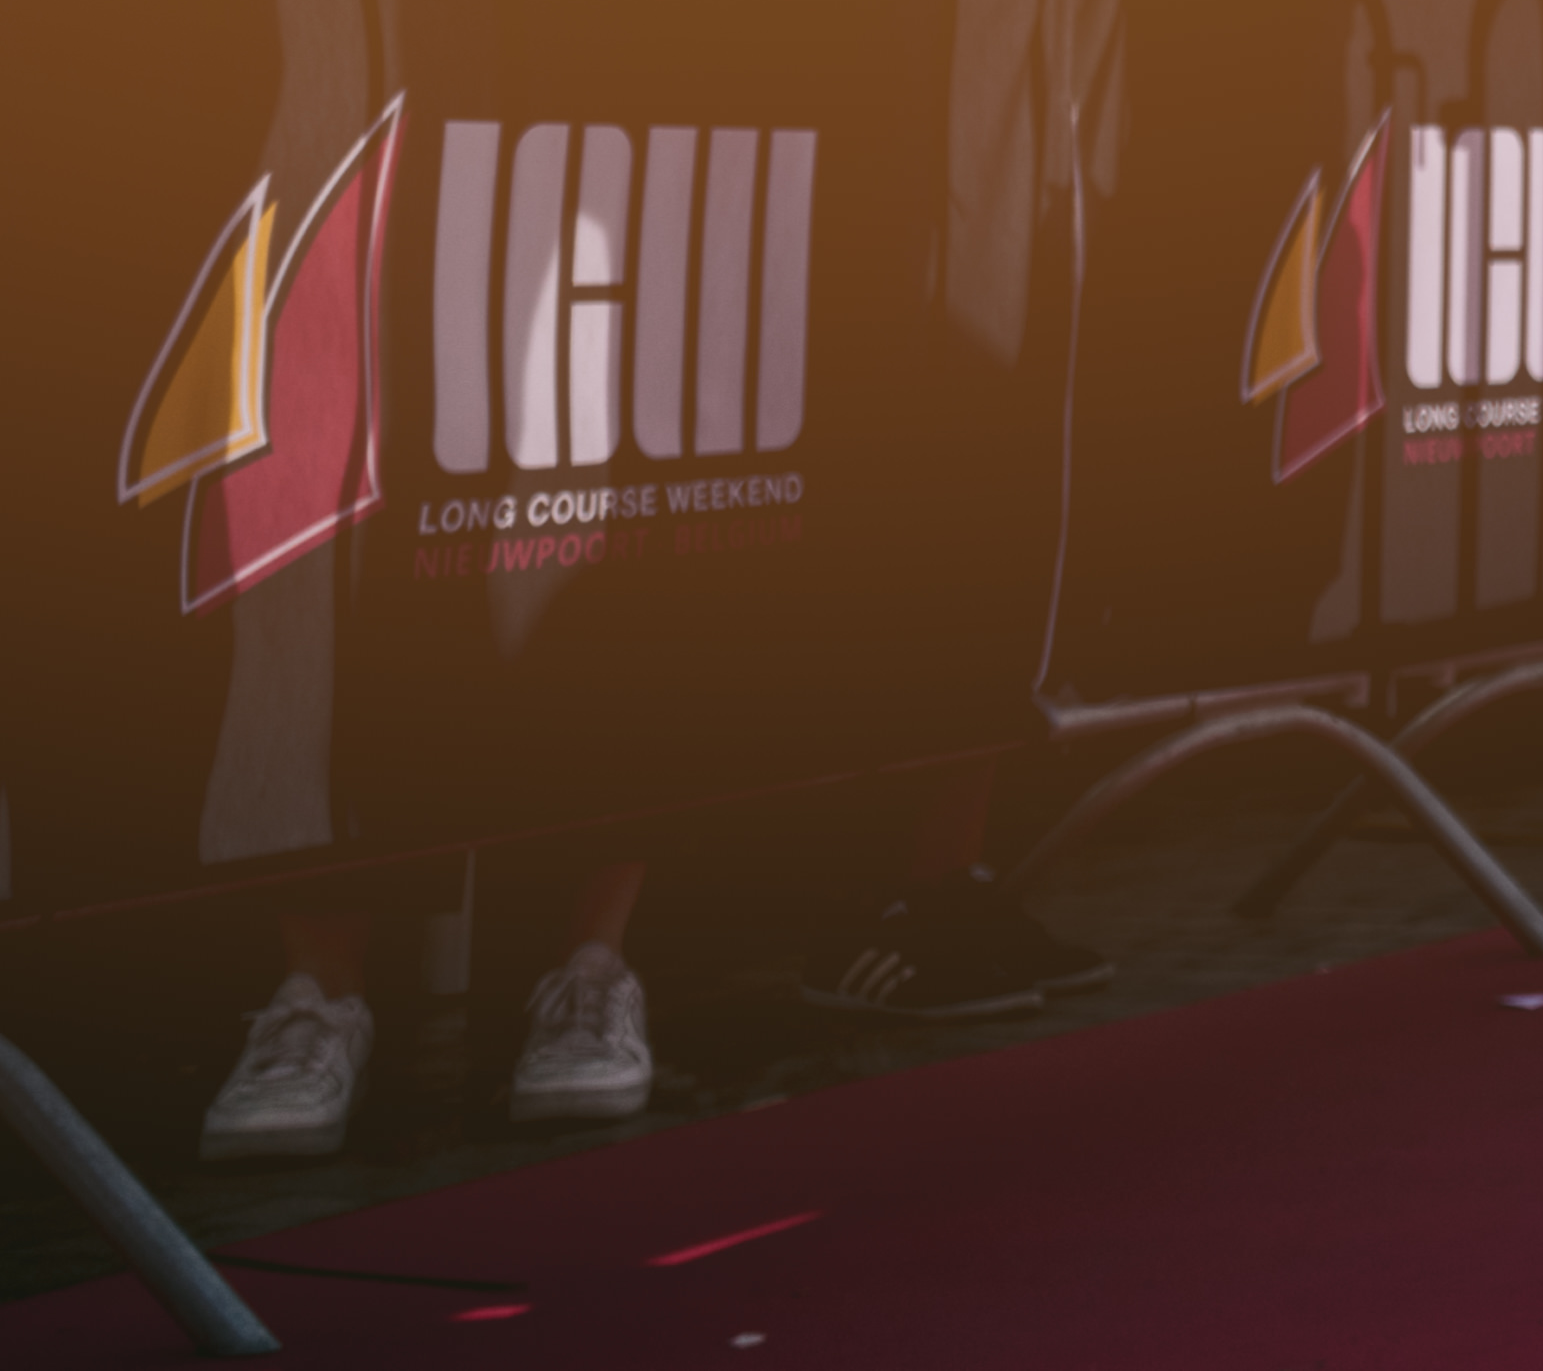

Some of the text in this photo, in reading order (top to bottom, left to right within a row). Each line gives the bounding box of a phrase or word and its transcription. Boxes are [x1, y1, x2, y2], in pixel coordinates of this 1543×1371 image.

[1403, 402, 1460, 434] LONG
[1464, 396, 1541, 429] COURSE
[417, 472, 804, 536] LONG COURSE WEEKEND
[413, 515, 803, 580] NIEUWPOORT BELGIUM
